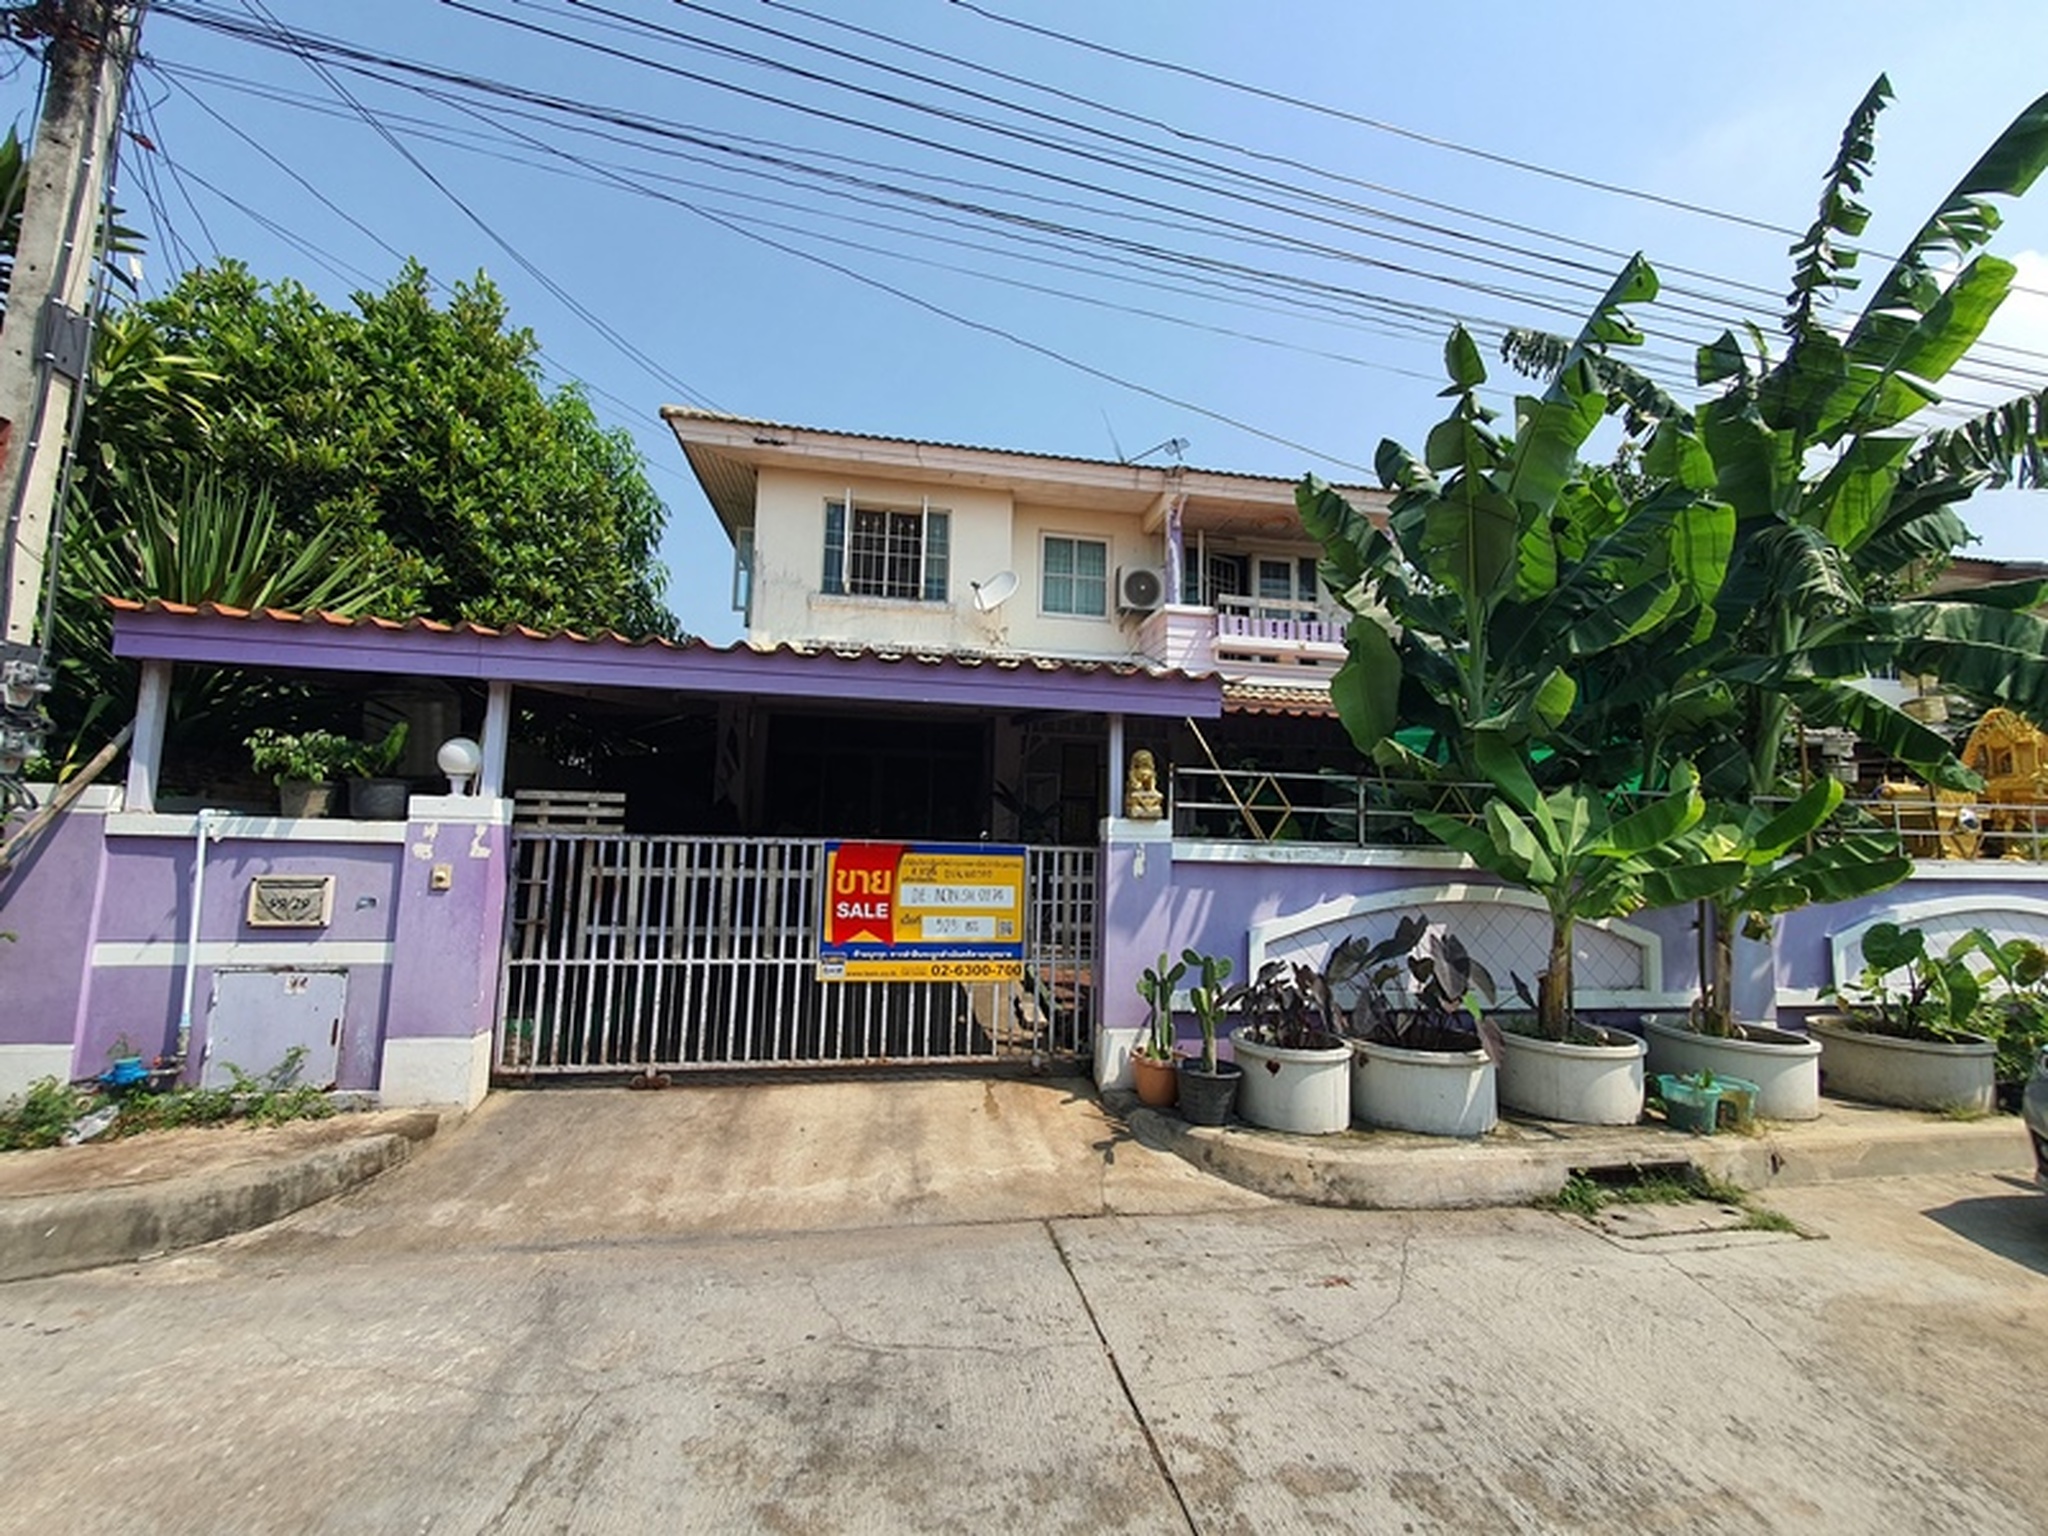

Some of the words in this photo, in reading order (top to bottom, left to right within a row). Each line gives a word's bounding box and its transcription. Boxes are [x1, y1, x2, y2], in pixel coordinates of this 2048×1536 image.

[836, 869, 891, 896] ขาย
[836, 902, 889, 919] SALE
[931, 964, 1022, 977] 02-6300-700
